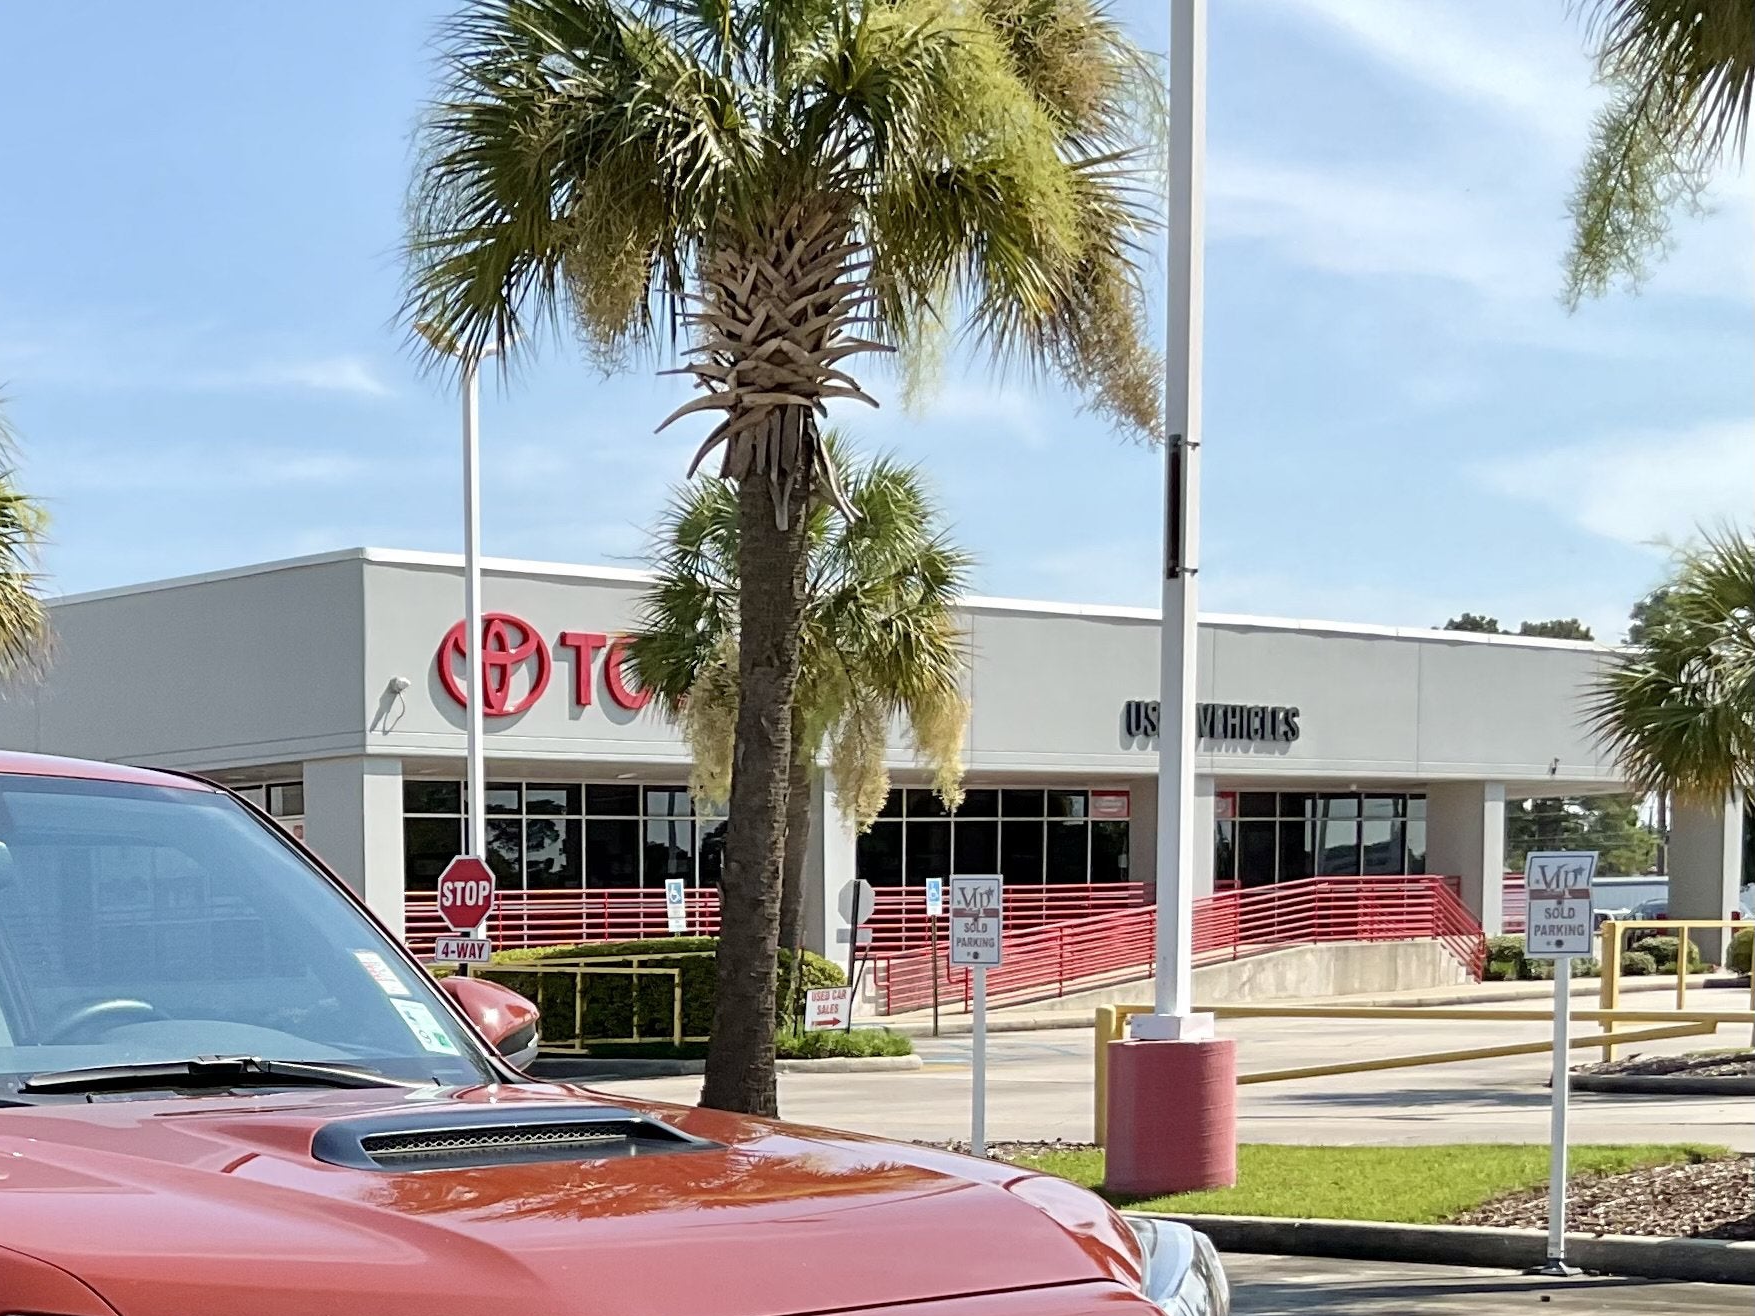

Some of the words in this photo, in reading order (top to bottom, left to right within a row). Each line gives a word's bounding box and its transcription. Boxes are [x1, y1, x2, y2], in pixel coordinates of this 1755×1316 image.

[1196, 702, 1300, 742] VEHICLES
[442, 880, 490, 907] STOP
[1544, 907, 1576, 920] SOLD
[963, 922, 988, 934] SOLD
[1533, 924, 1585, 937] PARKING
[955, 937, 995, 949] PARKING
[441, 942, 485, 960] 4-WAY
[811, 990, 831, 1002] USED
[832, 989, 847, 1001] CAR
[816, 1003, 839, 1016] SALES
